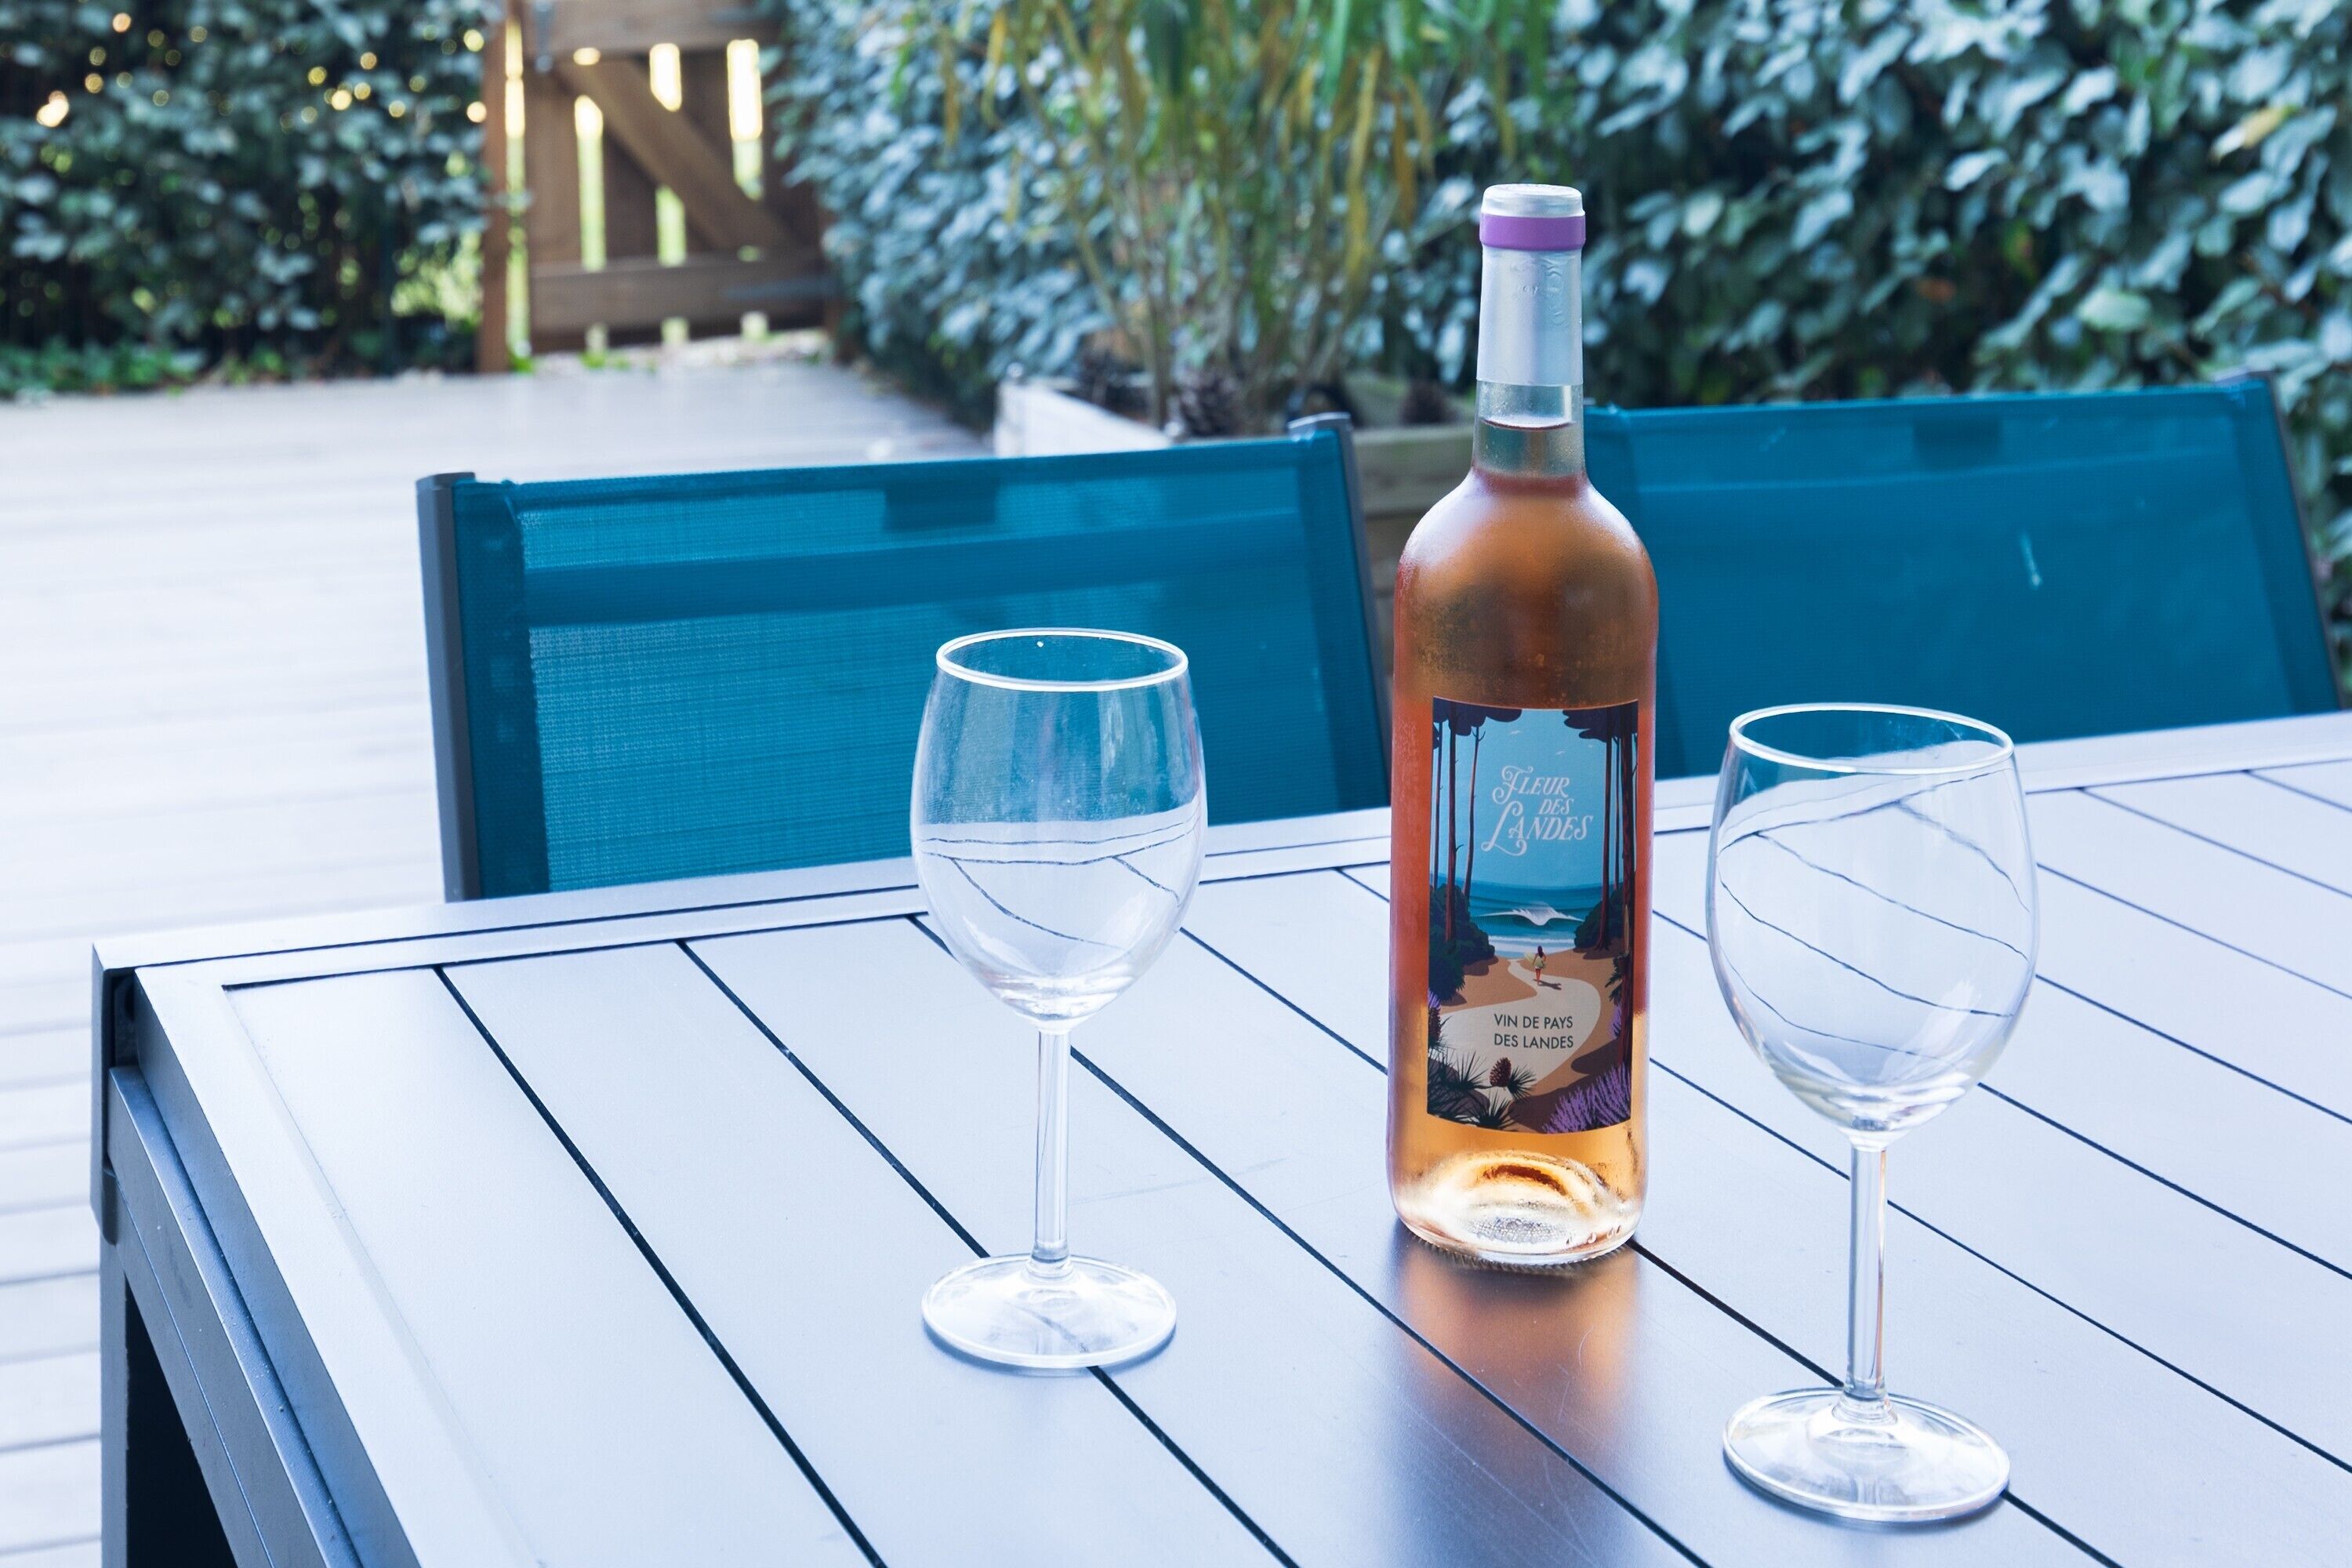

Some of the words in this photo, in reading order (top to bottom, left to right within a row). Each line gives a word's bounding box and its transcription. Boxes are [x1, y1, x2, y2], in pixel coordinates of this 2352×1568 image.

[1492, 765, 1570, 804] FLEUR
[1538, 798, 1574, 815] DES
[1481, 800, 1594, 856] LANDES
[1494, 1014, 1518, 1028] VIN
[1523, 1016, 1539, 1029] DE
[1544, 1016, 1573, 1029] PAYS
[1494, 1033, 1518, 1047] DES
[1523, 1036, 1573, 1049] LANDES
